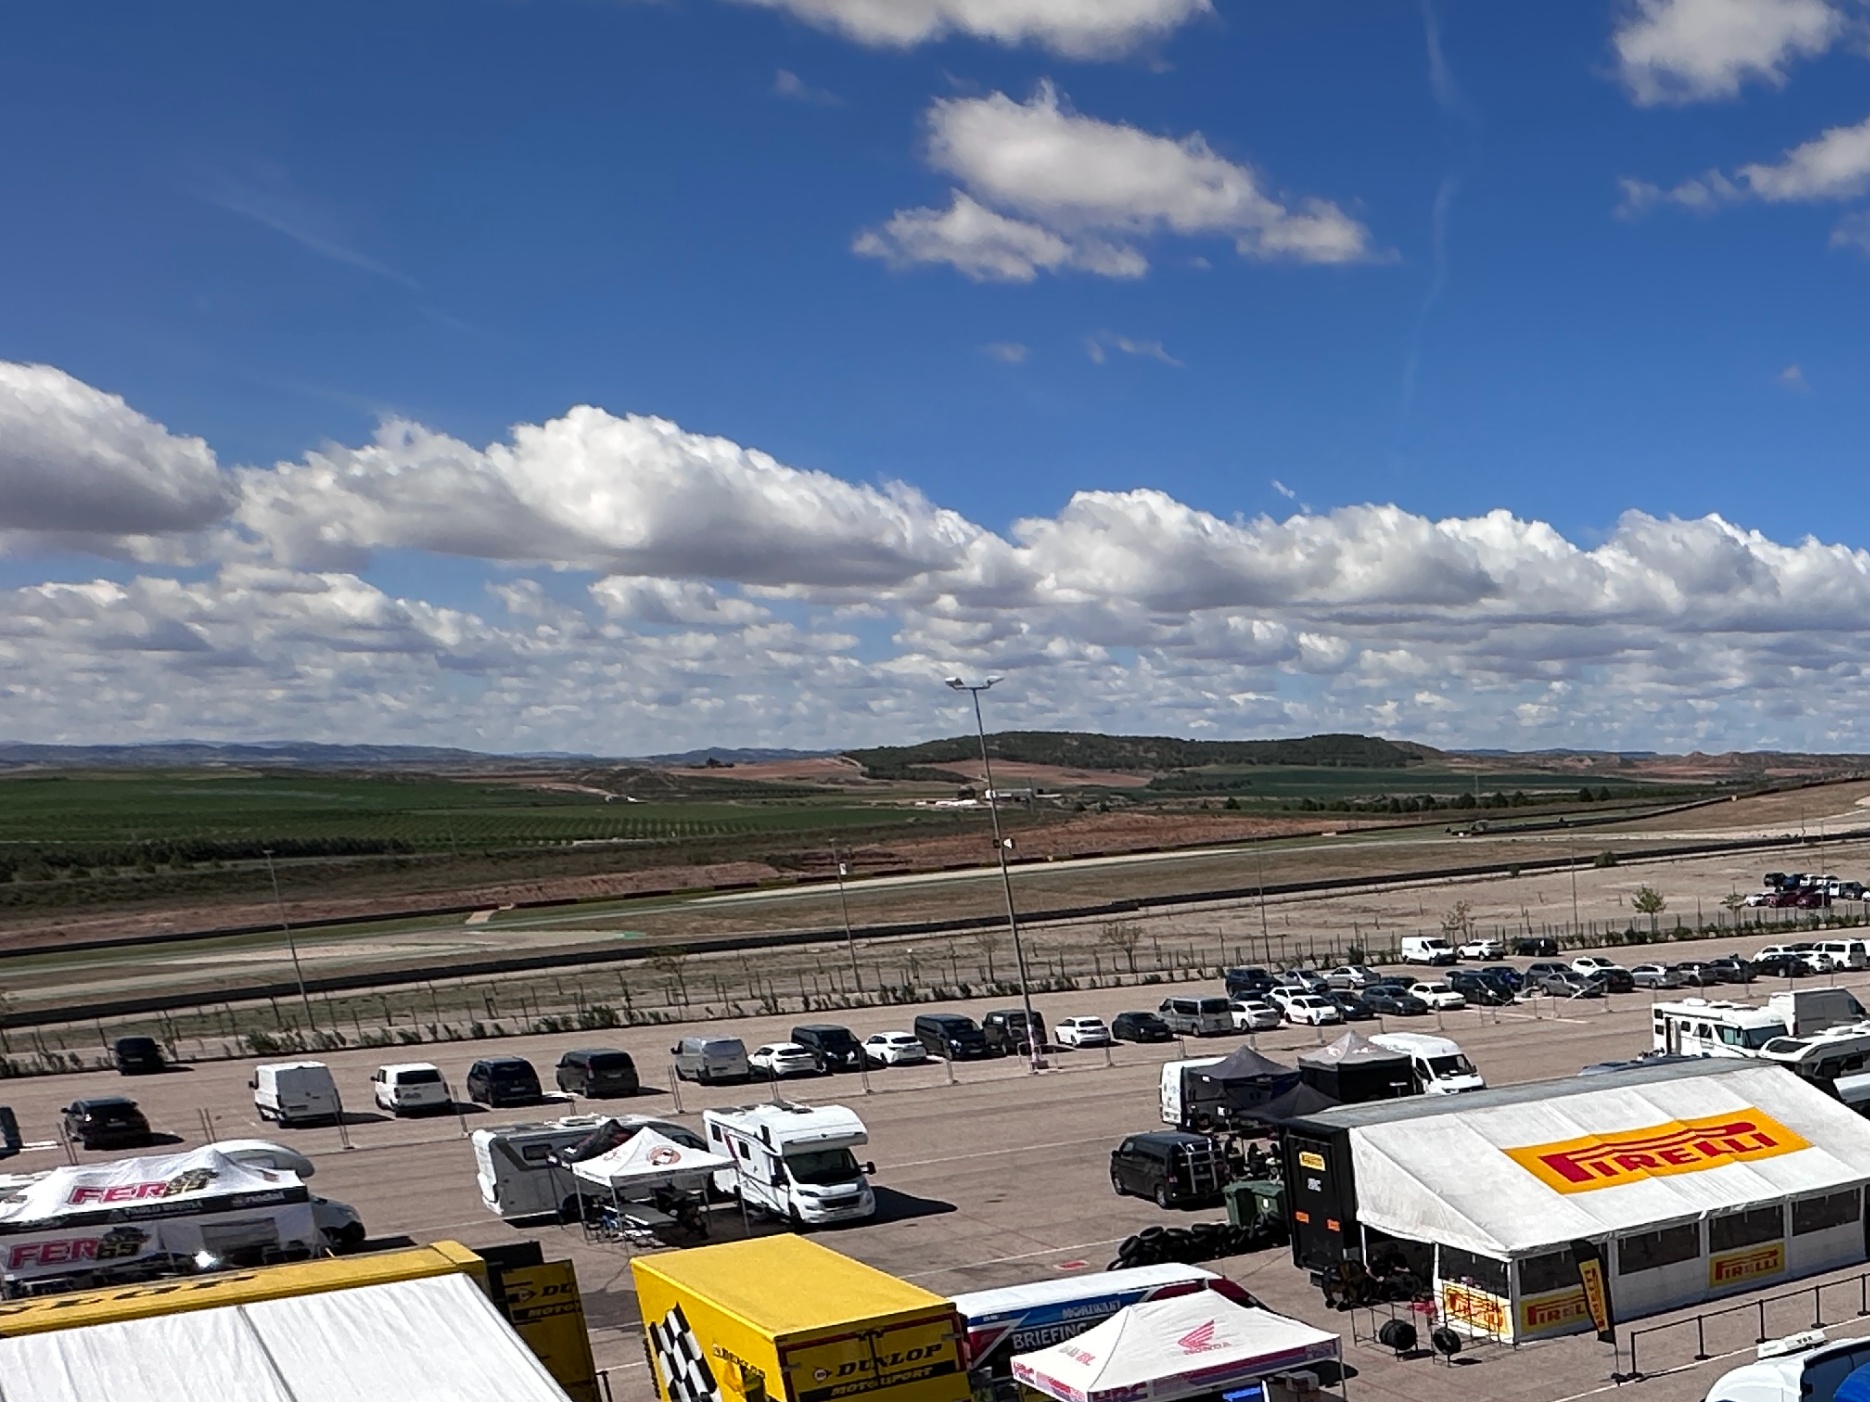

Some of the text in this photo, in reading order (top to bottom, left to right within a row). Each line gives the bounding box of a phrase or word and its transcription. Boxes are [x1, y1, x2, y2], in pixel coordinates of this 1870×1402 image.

[1539, 1121, 1778, 1183] PIRELLI
[1715, 1249, 1779, 1281] PIRELLI
[1012, 1323, 1087, 1350] BRIEFING
[1184, 1342, 1231, 1356] HONDA
[836, 1343, 942, 1377] DUNLOP
